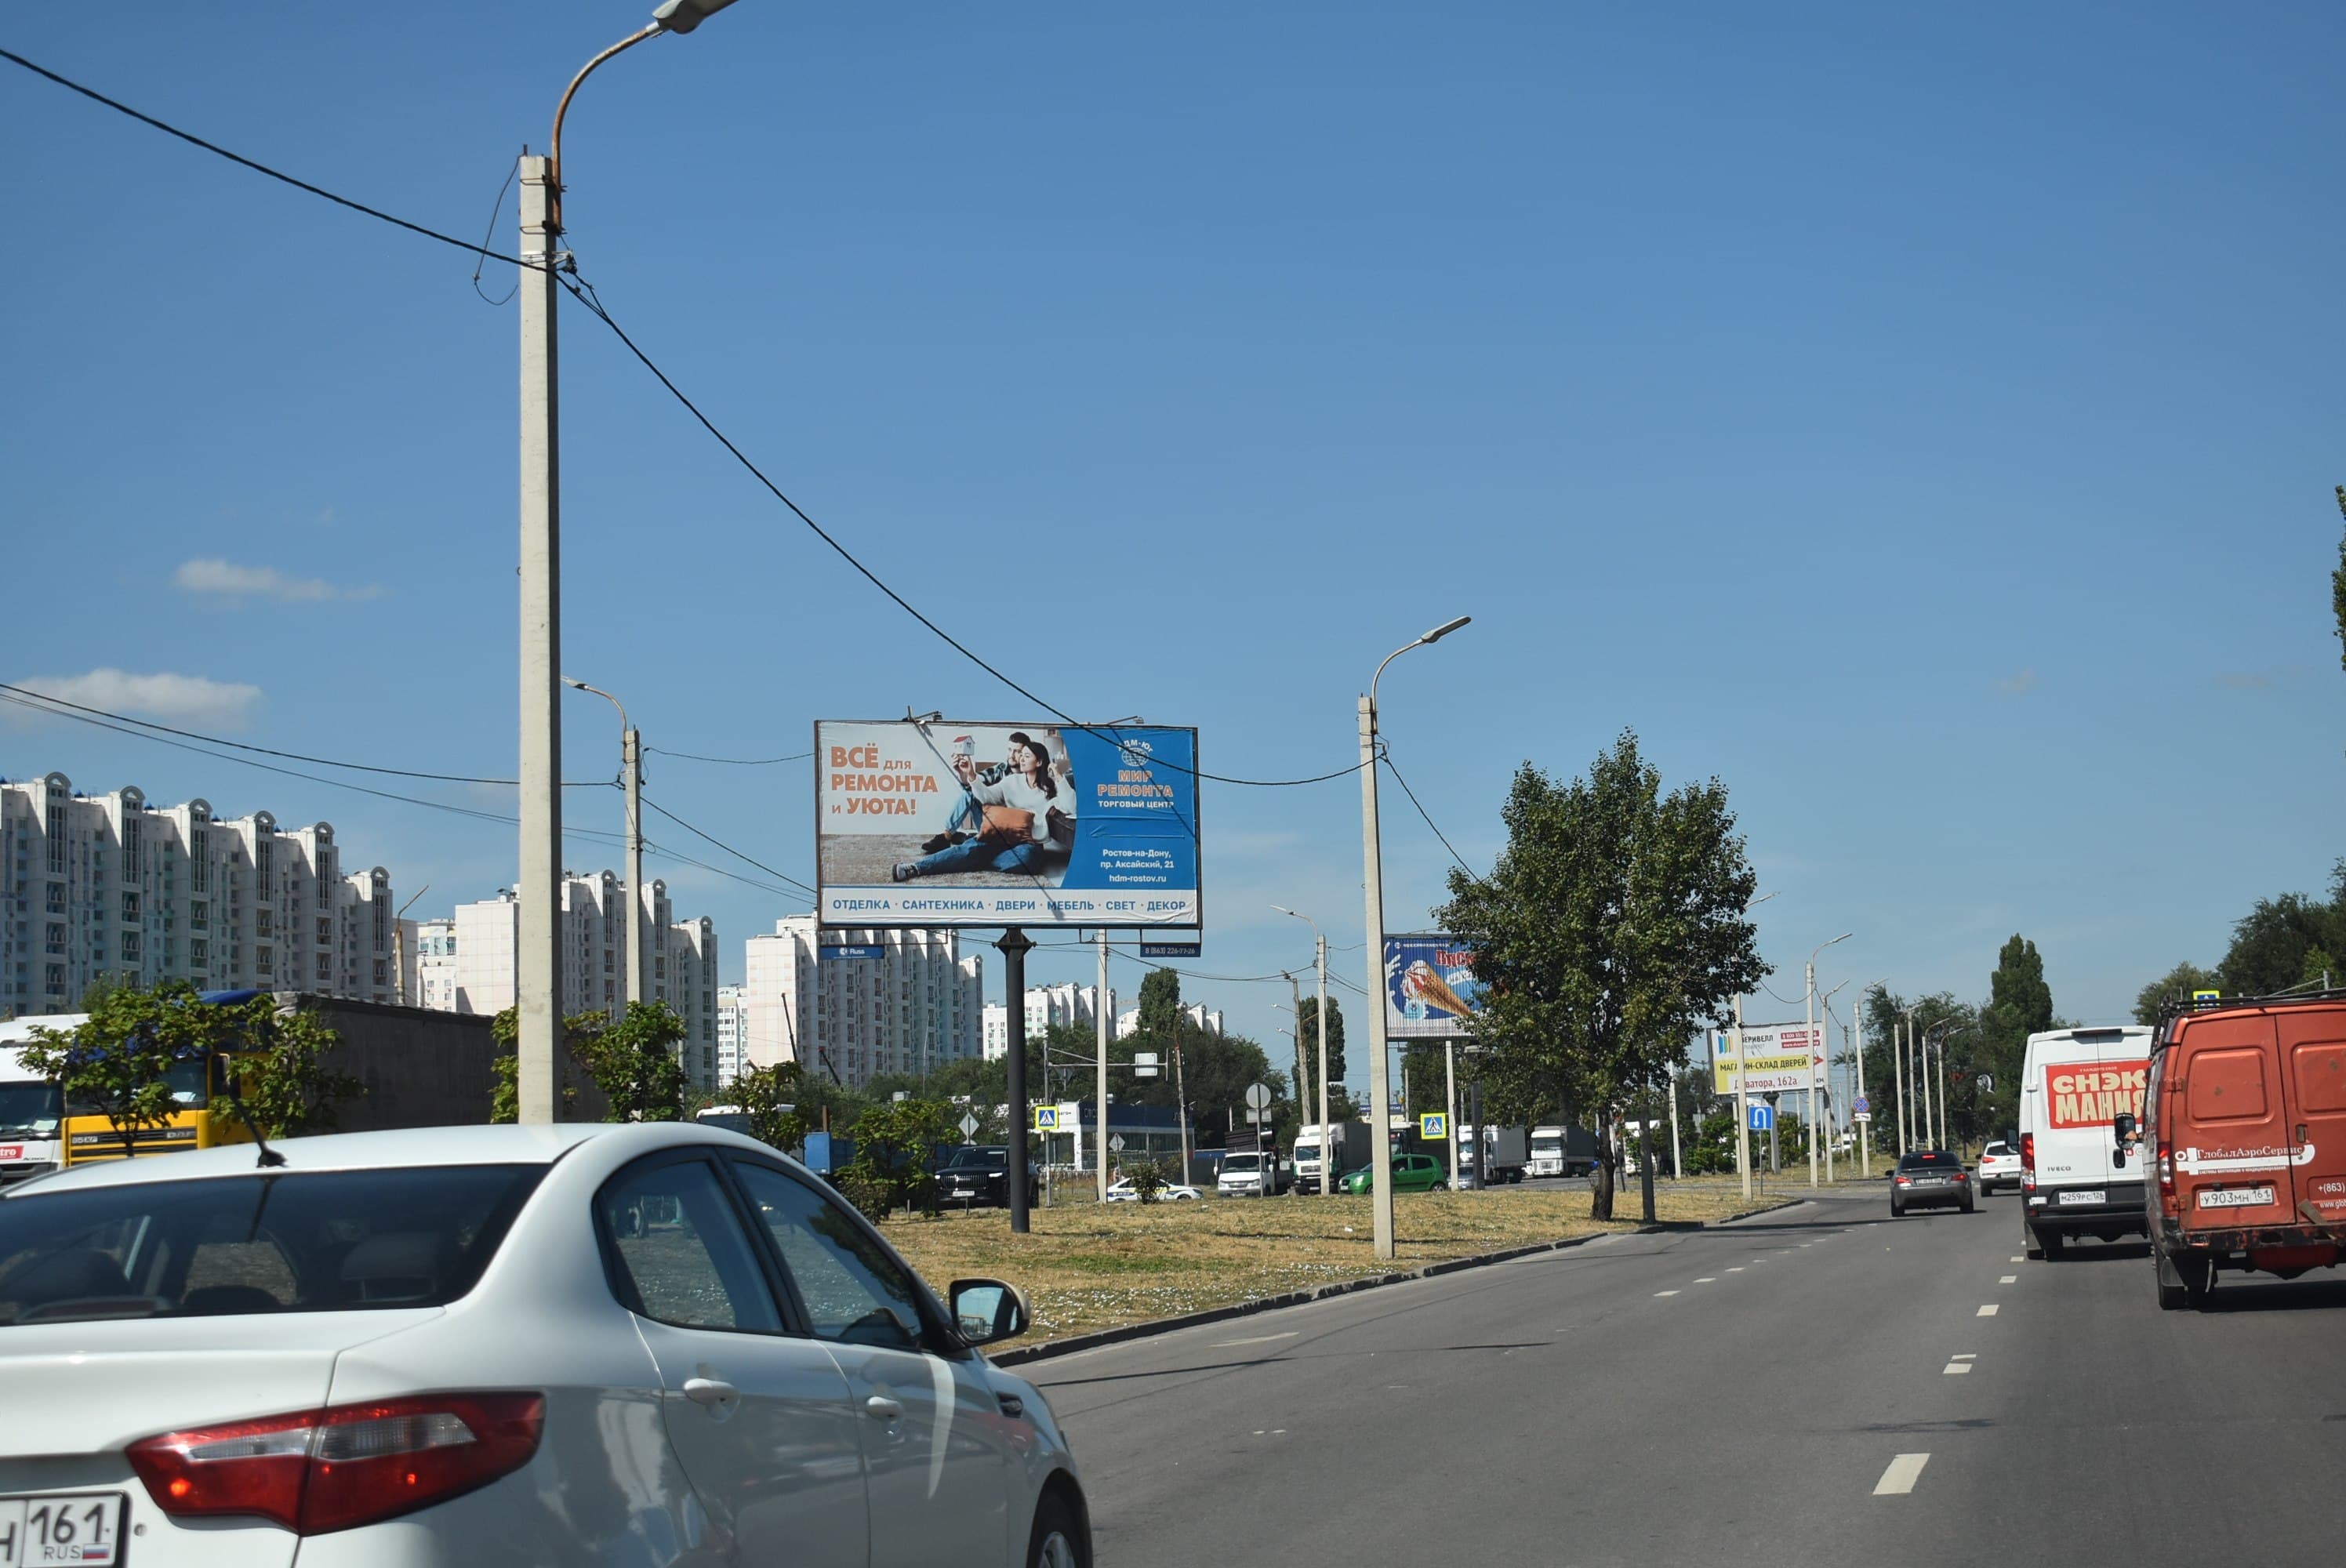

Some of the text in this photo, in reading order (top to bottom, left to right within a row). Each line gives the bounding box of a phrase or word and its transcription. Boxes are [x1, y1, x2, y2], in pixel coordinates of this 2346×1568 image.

[831, 742, 911, 771] ВСЁ для
[1118, 770, 1153, 782] МИР
[831, 774, 939, 792] РЕМОНТА
[1098, 784, 1174, 797] РЕМОНТА
[847, 798, 916, 815] УЮТА!
[1147, 800, 1175, 809] ЦЕНТР
[1102, 849, 1171, 858] Ростов-на-Дону,
[1115, 860, 1163, 869] Аксайский,
[833, 899, 1186, 912] ОТДЕЛКА САНТЕХНИКА ДВЕРИ МЕБЕЛЬ СВЕТ ДЕКОР
[1780, 1058, 1807, 1068] ДВЕРЕЙ
[1778, 1076, 1798, 1087] 162а
[2052, 1069, 2146, 1094] СНЭК
[2197, 1145, 2303, 1160] ГлобалАэроСервис
[30, 1503, 104, 1545] 161
[44, 1544, 81, 1560] RUS
